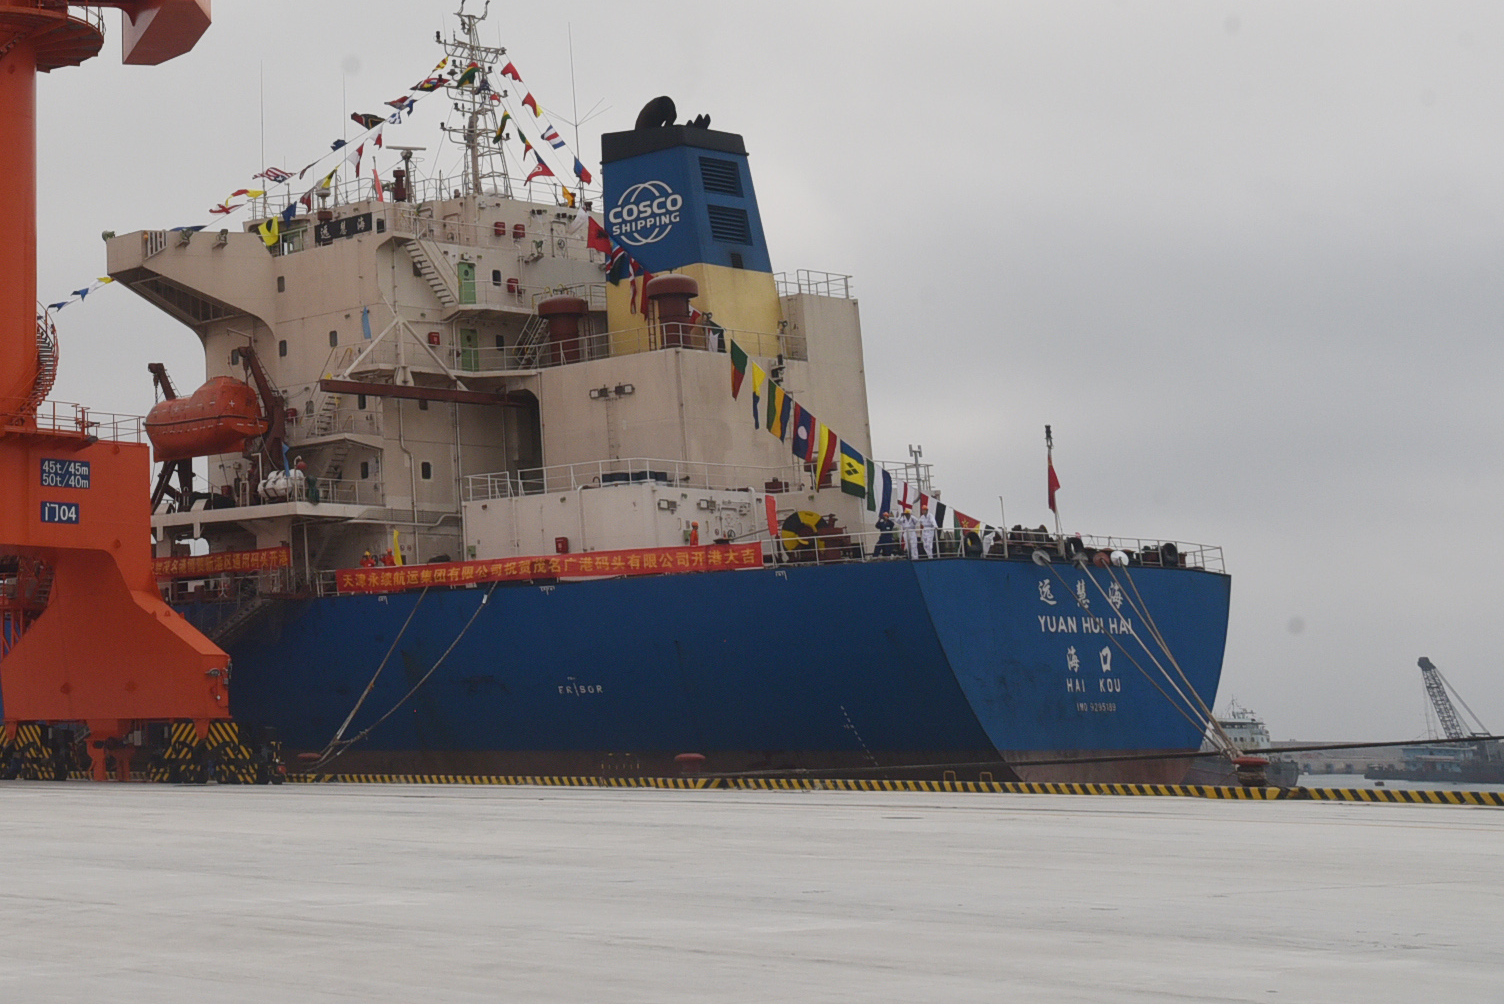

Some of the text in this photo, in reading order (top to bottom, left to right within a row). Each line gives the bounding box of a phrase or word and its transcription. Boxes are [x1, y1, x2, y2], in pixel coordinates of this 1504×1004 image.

[609, 194, 683, 223] COSCO
[612, 212, 680, 236] SHIPPING
[42, 460, 89, 475] 45t/45m
[42, 474, 89, 489] 50t/40m
[45, 502, 77, 522] 门04
[1037, 615, 1077, 633] YUAN
[1082, 616, 1105, 634] HUI
[1066, 678, 1121, 693] HAI KOU
